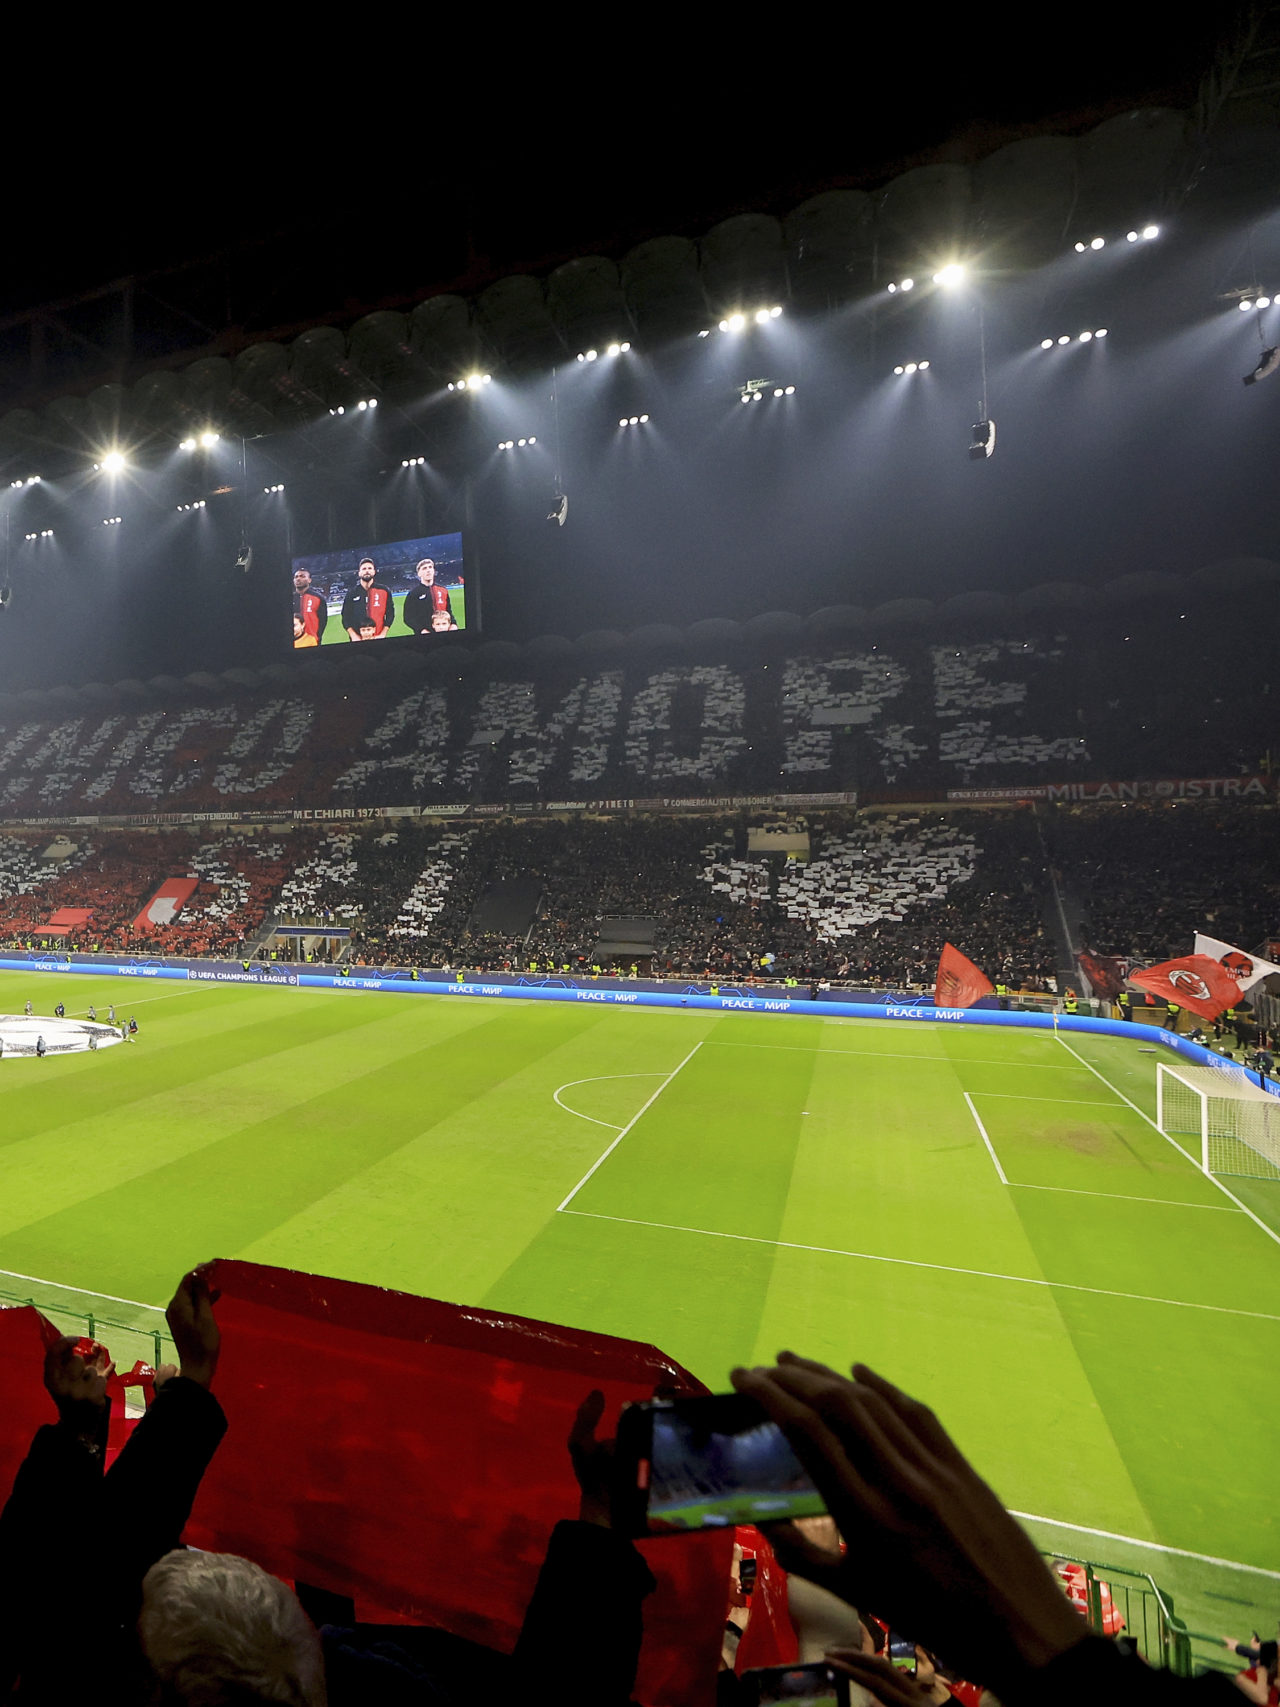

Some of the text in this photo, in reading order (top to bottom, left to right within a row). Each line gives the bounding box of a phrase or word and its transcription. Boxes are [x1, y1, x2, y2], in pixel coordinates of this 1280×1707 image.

[1047, 781, 1138, 801] MILAN
[1179, 778, 1267, 797] ISTRA
[670, 799, 731, 807] COMMERCIALISTI
[314, 808, 355, 819] CHIARI
[357, 808, 381, 818] 1973
[35, 962, 54, 971] PEACE
[118, 967, 138, 976] PEACE
[198, 971, 288, 984] UEFA CHAMPIONS LEAGUE
[333, 978, 357, 988] PEACE
[448, 984, 475, 995] PEACE
[576, 990, 607, 1001] PEACE
[721, 999, 791, 1011] PEACE МИР
[886, 1007, 966, 1021] PEACE МИР
